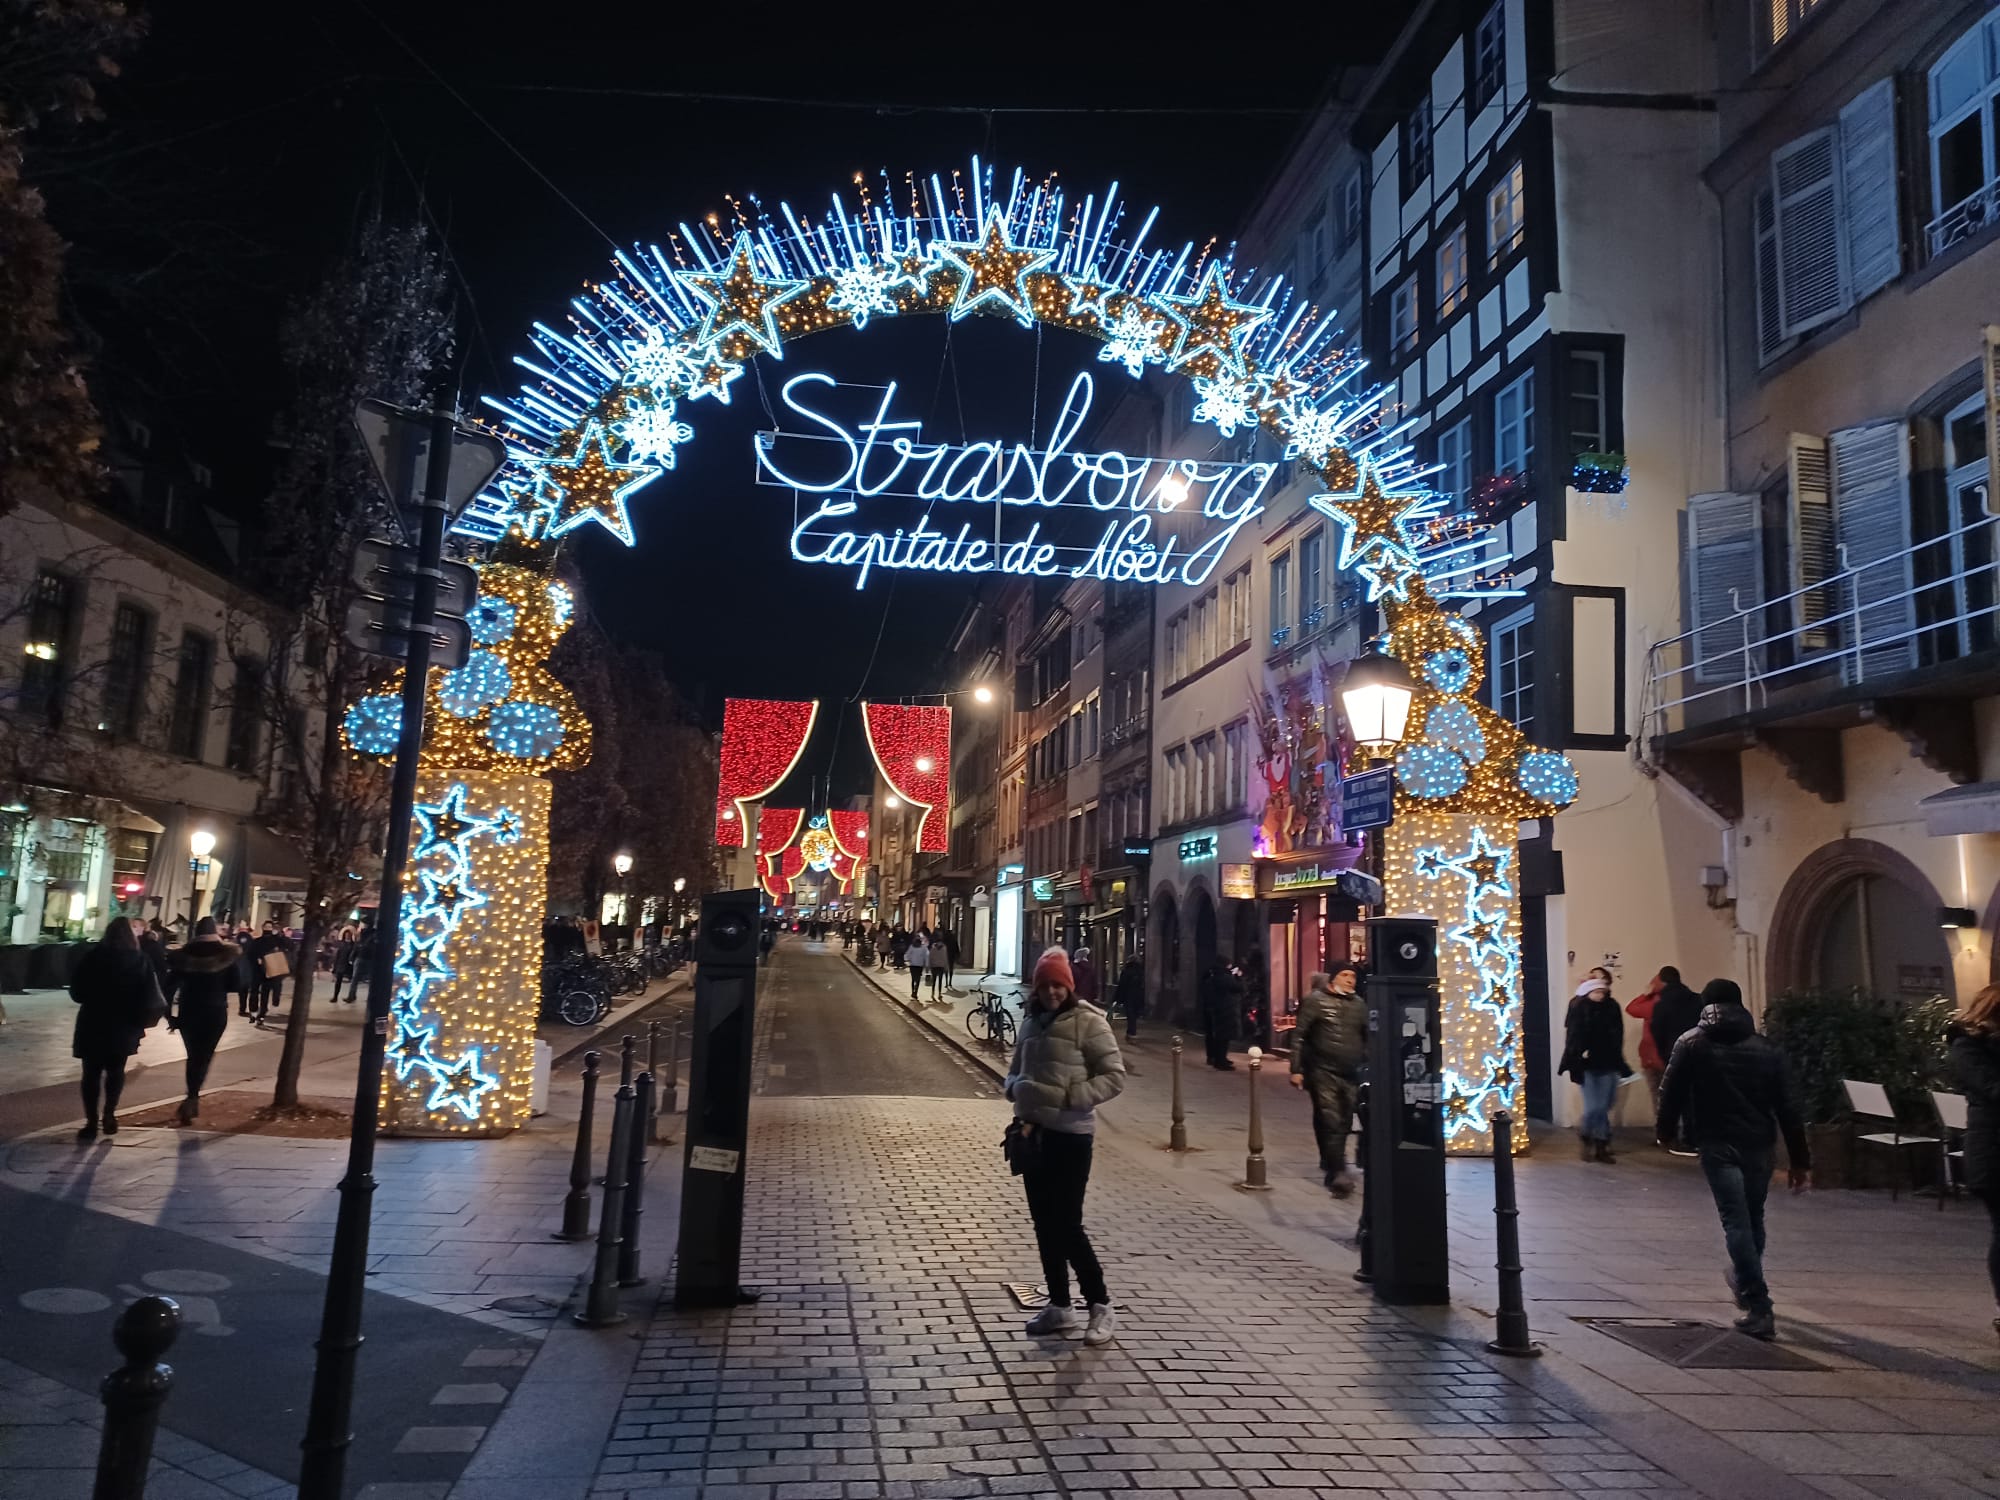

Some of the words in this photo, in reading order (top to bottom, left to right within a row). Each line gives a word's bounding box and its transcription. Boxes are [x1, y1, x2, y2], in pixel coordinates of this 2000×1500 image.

[754, 371, 1278, 586] Strasbourg
[791, 498, 996, 590] Capitale
[1002, 521, 1060, 577] de
[1070, 514, 1177, 584] Noël
